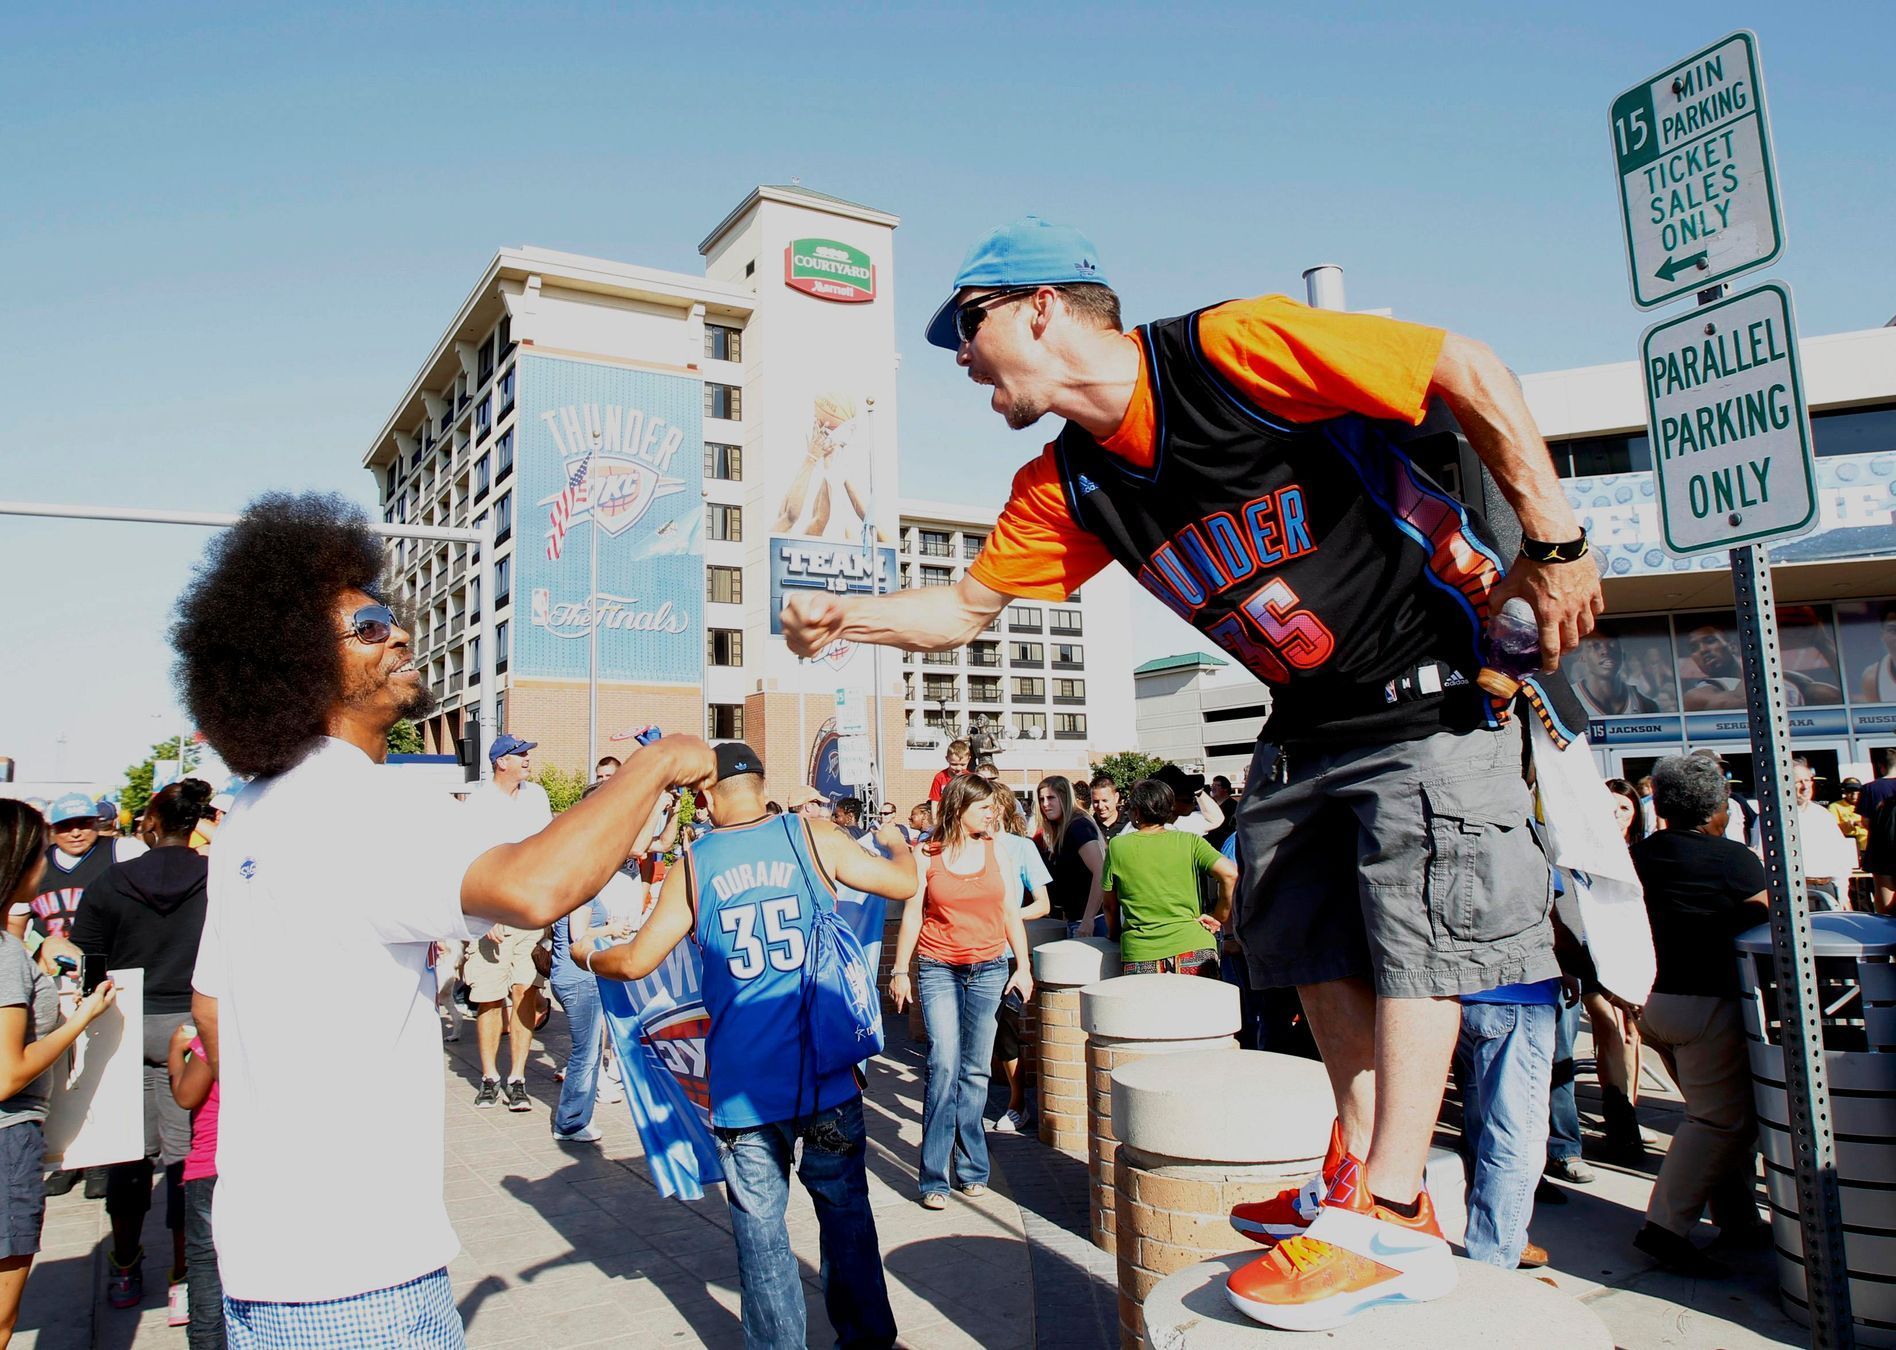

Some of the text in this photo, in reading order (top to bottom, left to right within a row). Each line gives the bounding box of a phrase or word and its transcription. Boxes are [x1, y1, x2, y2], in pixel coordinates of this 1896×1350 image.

[1675, 55, 1723, 103] MIN
[1616, 107, 1648, 156] 15
[1662, 81, 1747, 145] PARKING
[1643, 129, 1735, 195] TICKET
[1650, 163, 1739, 225] SALES
[1662, 198, 1731, 252] ONLY
[794, 254, 870, 279] COURTYARD
[1651, 318, 1786, 399] PARALLEL
[540, 403, 684, 474] THUNDER
[1661, 383, 1790, 460] PARKING
[1688, 456, 1771, 519] ONLY
[781, 546, 887, 580] TEAM
[586, 592, 689, 635] Finals
[1591, 724, 1662, 737] 15 JACKSON
[1715, 718, 1815, 731] SERG AKA
[711, 860, 796, 902] DURANT
[717, 893, 808, 981] 35
